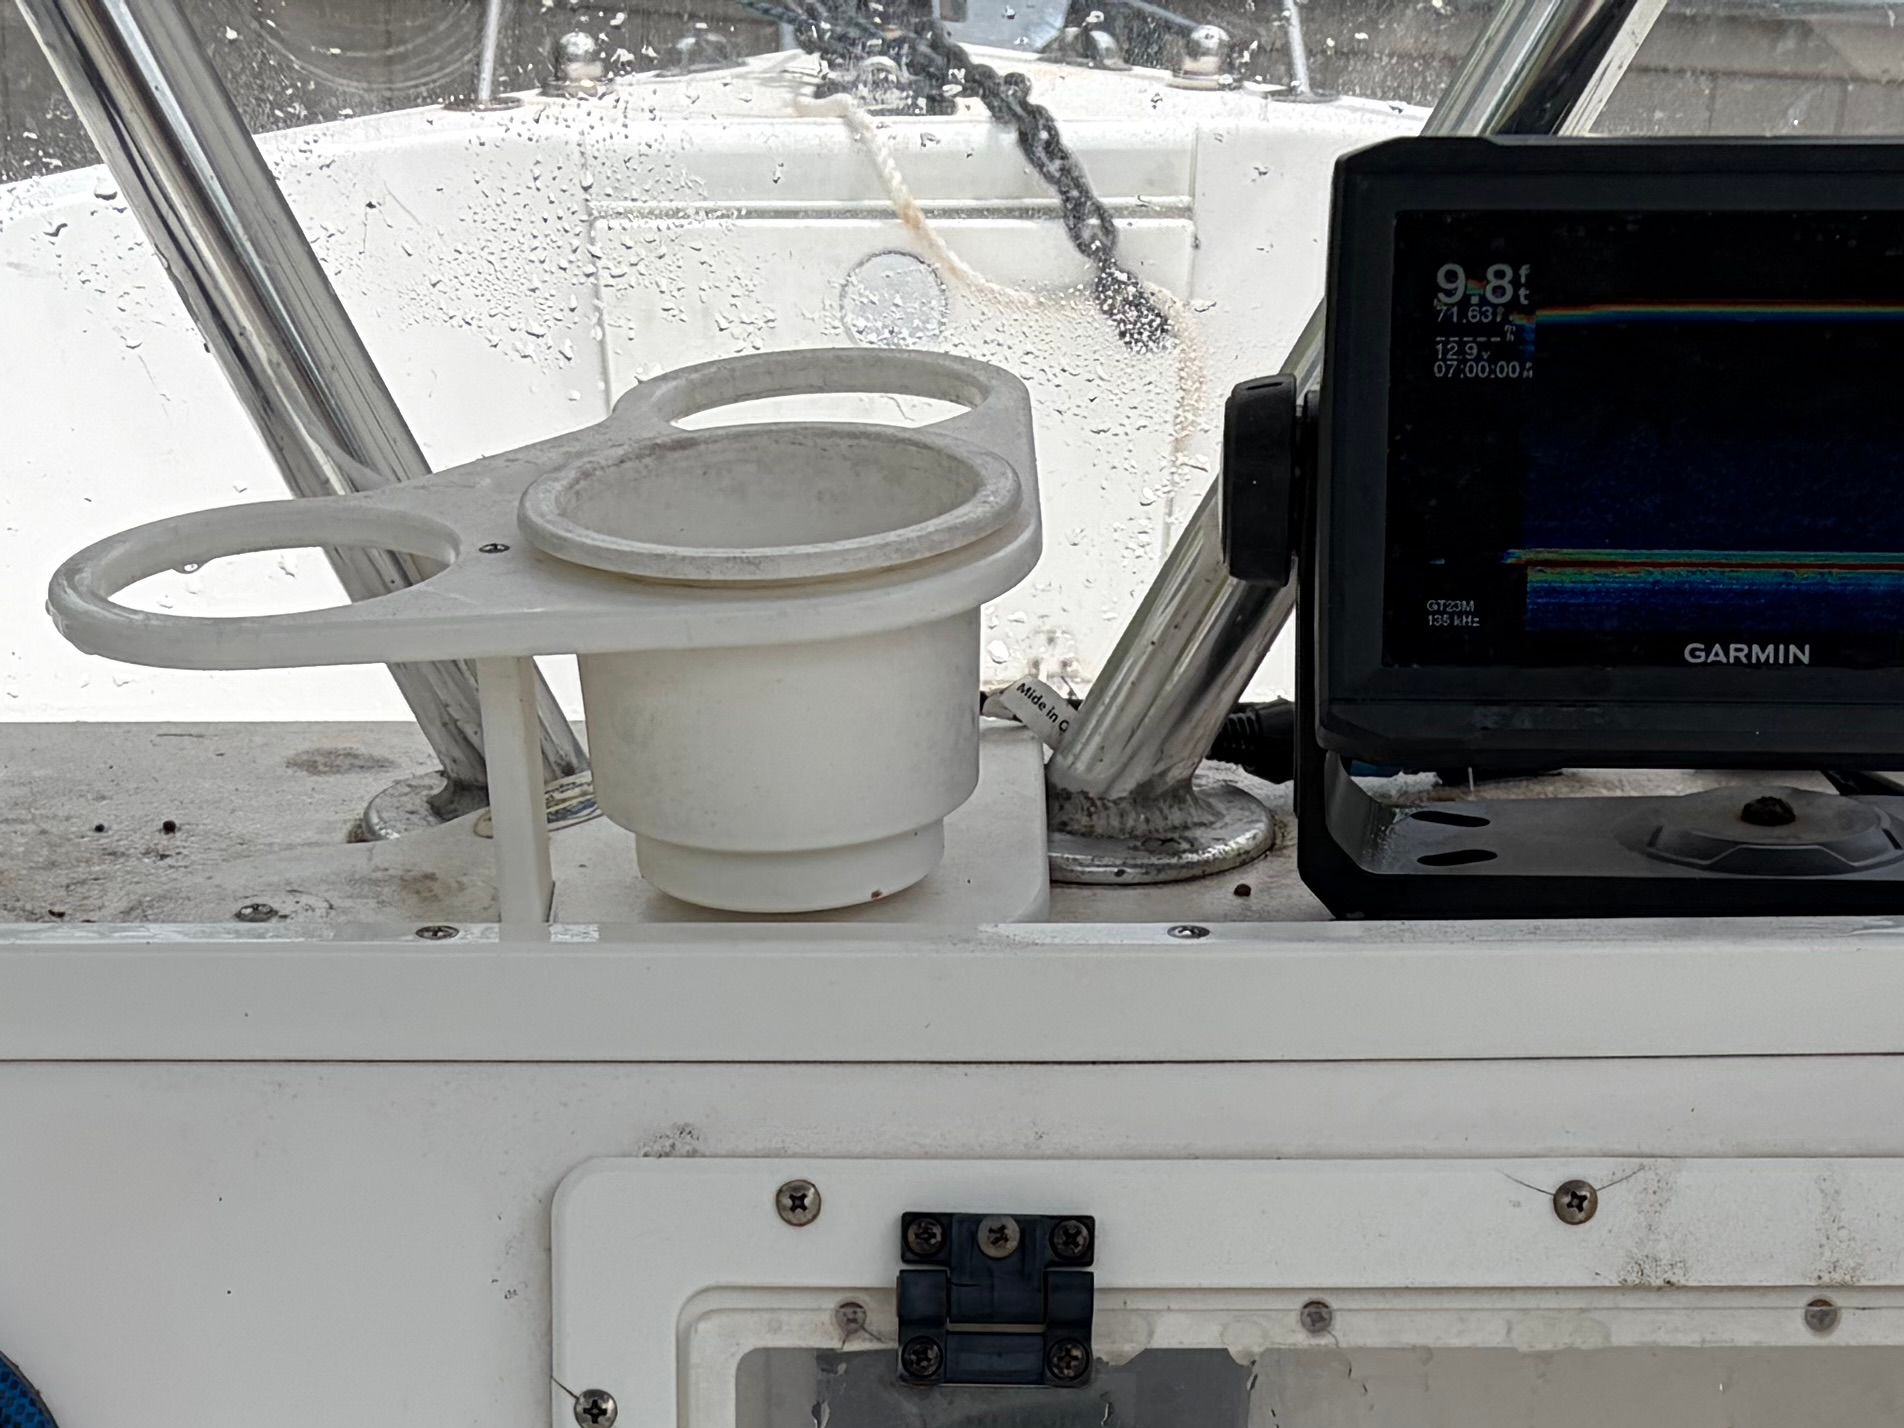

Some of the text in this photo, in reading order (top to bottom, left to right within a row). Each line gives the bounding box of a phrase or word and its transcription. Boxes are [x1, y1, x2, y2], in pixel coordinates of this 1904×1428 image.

[1436, 263, 1514, 304] 9.8
[1435, 342, 1478, 359] 12.9
[1433, 360, 1520, 378] 07:00:00
[1428, 614, 1480, 627] 135 kHz
[1684, 642, 1810, 665] GARMIN
